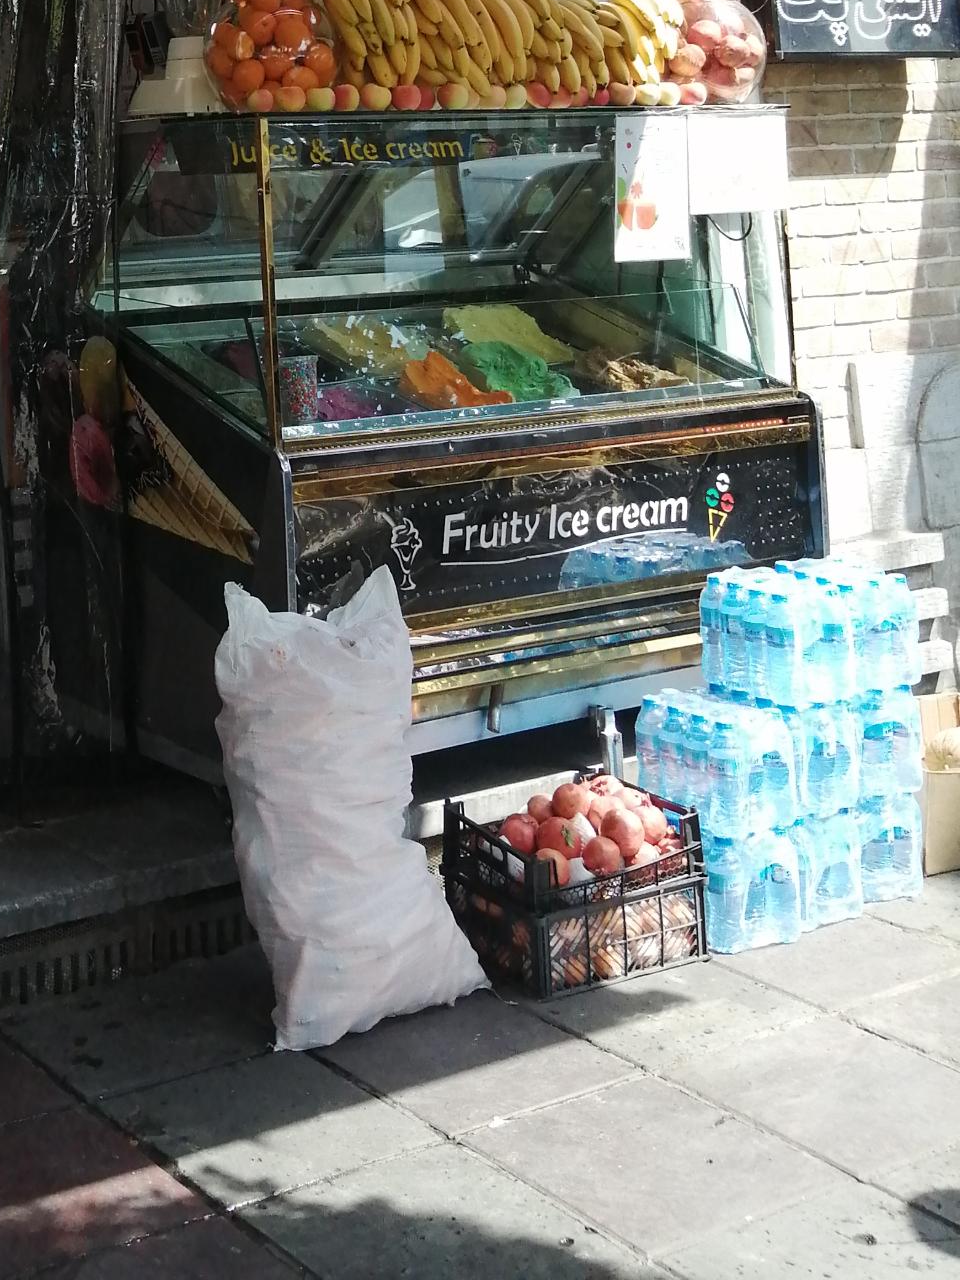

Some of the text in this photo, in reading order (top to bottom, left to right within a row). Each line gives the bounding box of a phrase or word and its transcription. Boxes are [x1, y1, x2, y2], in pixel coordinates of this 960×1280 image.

[228, 137, 464, 166] Juce & Ice cream
[441, 494, 688, 555] Fruity Ice cream
